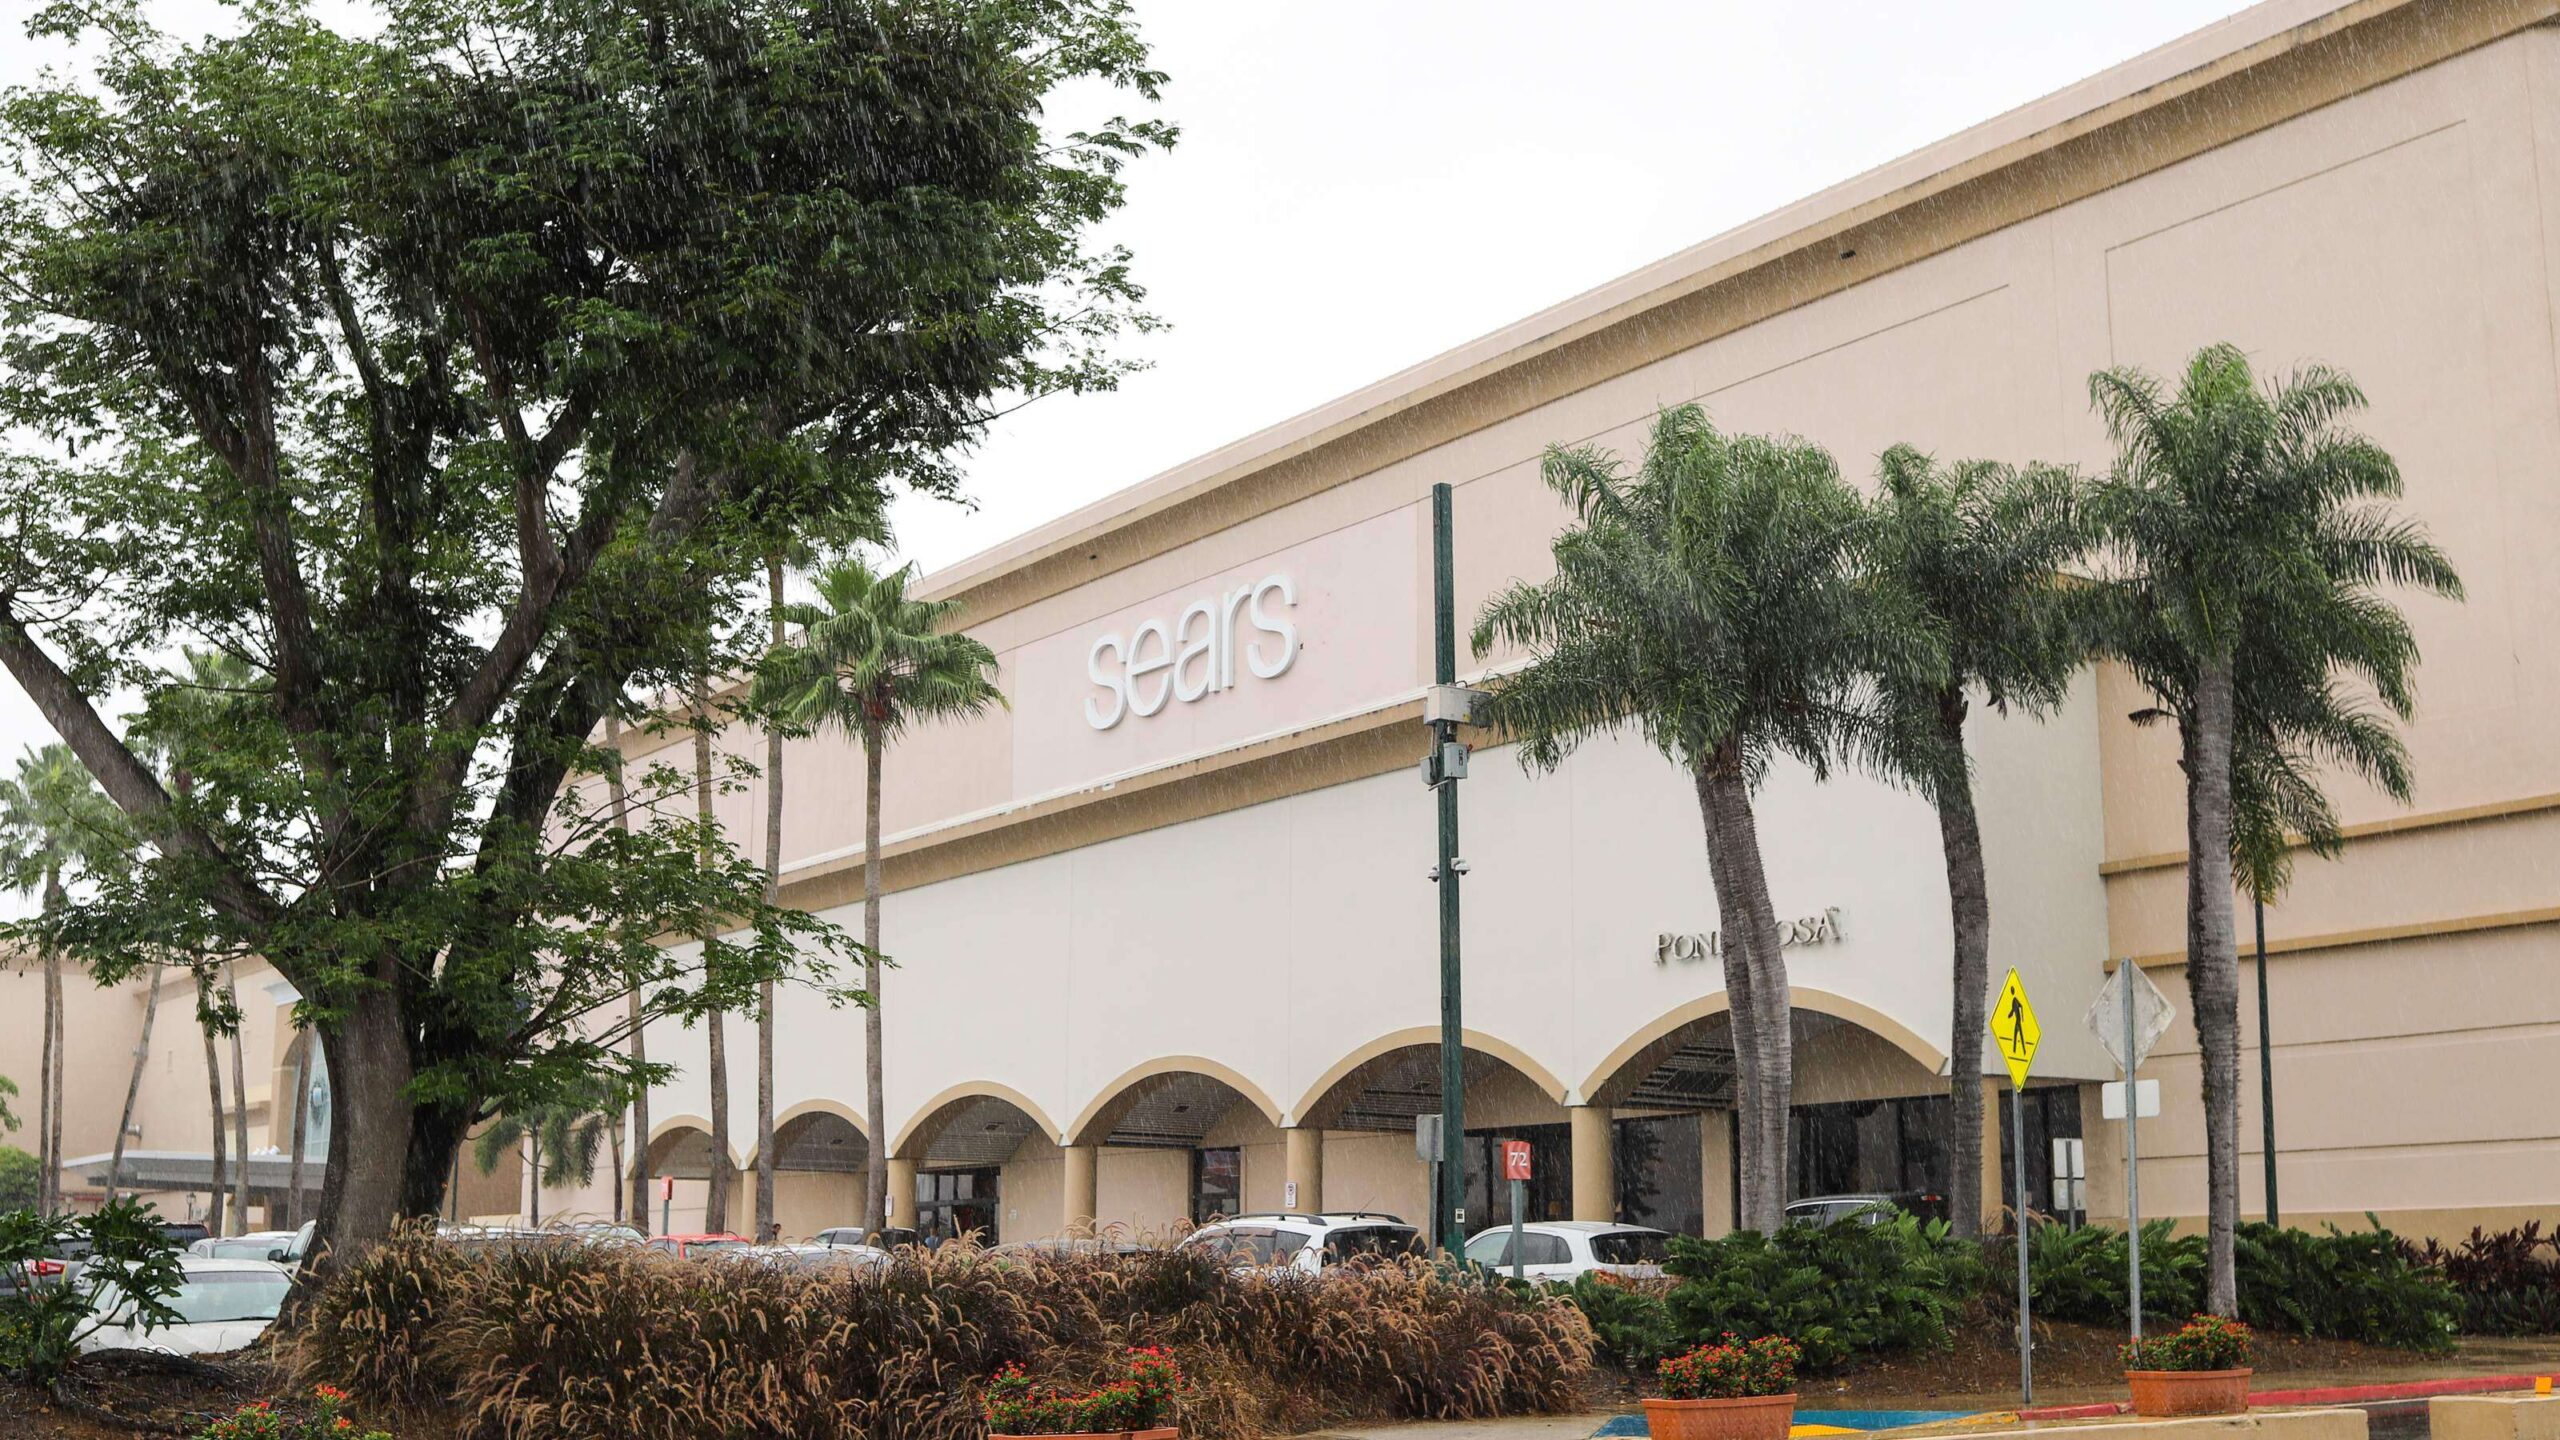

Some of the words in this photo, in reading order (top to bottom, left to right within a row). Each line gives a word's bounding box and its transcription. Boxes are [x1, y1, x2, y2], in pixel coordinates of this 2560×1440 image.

[1083, 573, 1298, 731] sears
[1654, 907, 1841, 966] PONOSA
[1510, 1151, 1528, 1168] 72
